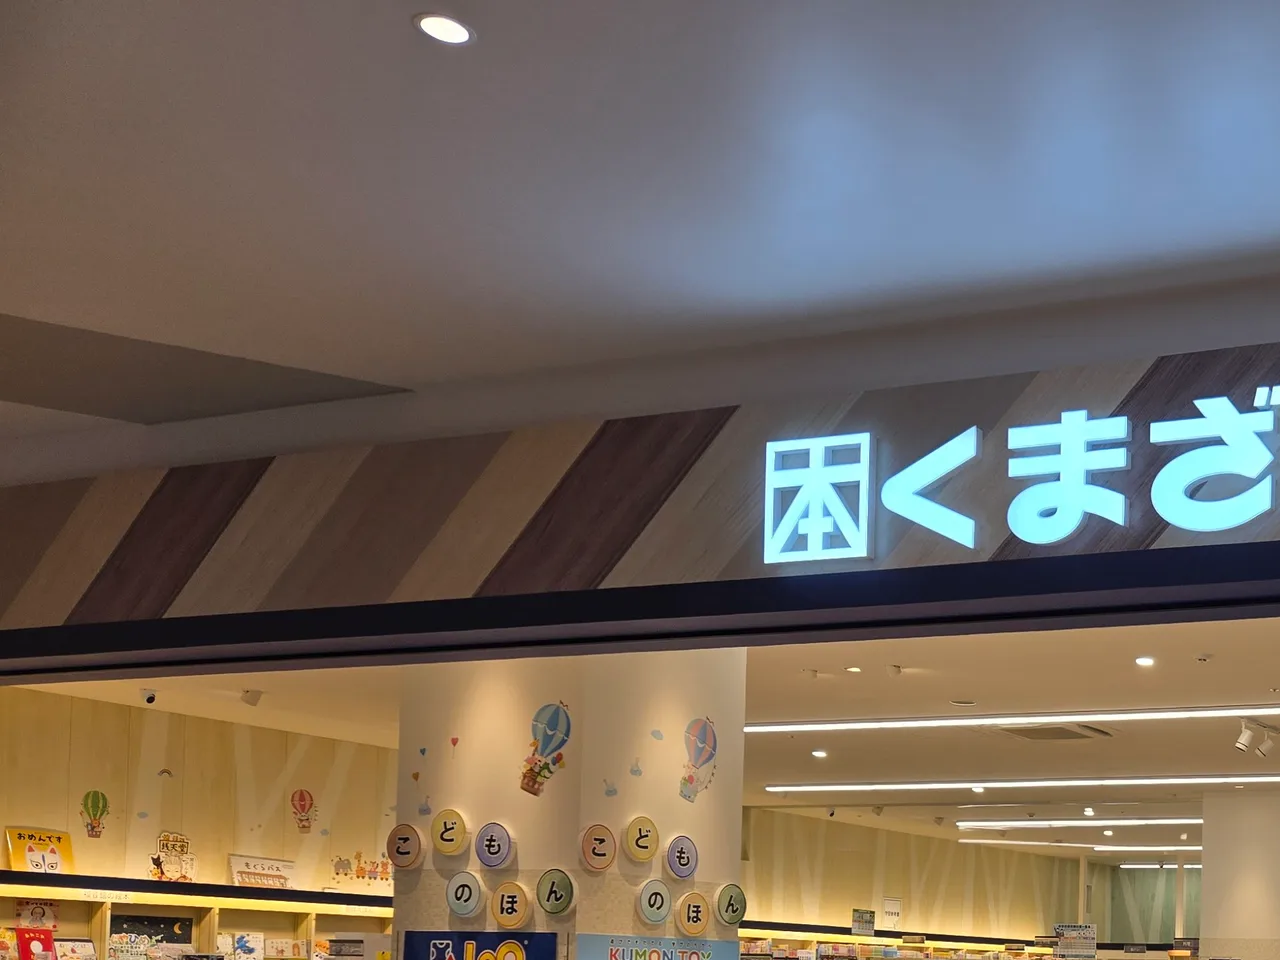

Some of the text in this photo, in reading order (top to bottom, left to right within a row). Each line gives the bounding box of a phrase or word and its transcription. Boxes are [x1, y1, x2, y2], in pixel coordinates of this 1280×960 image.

[17, 832, 63, 845] おめんです
[244, 861, 281, 873] もぐらバス
